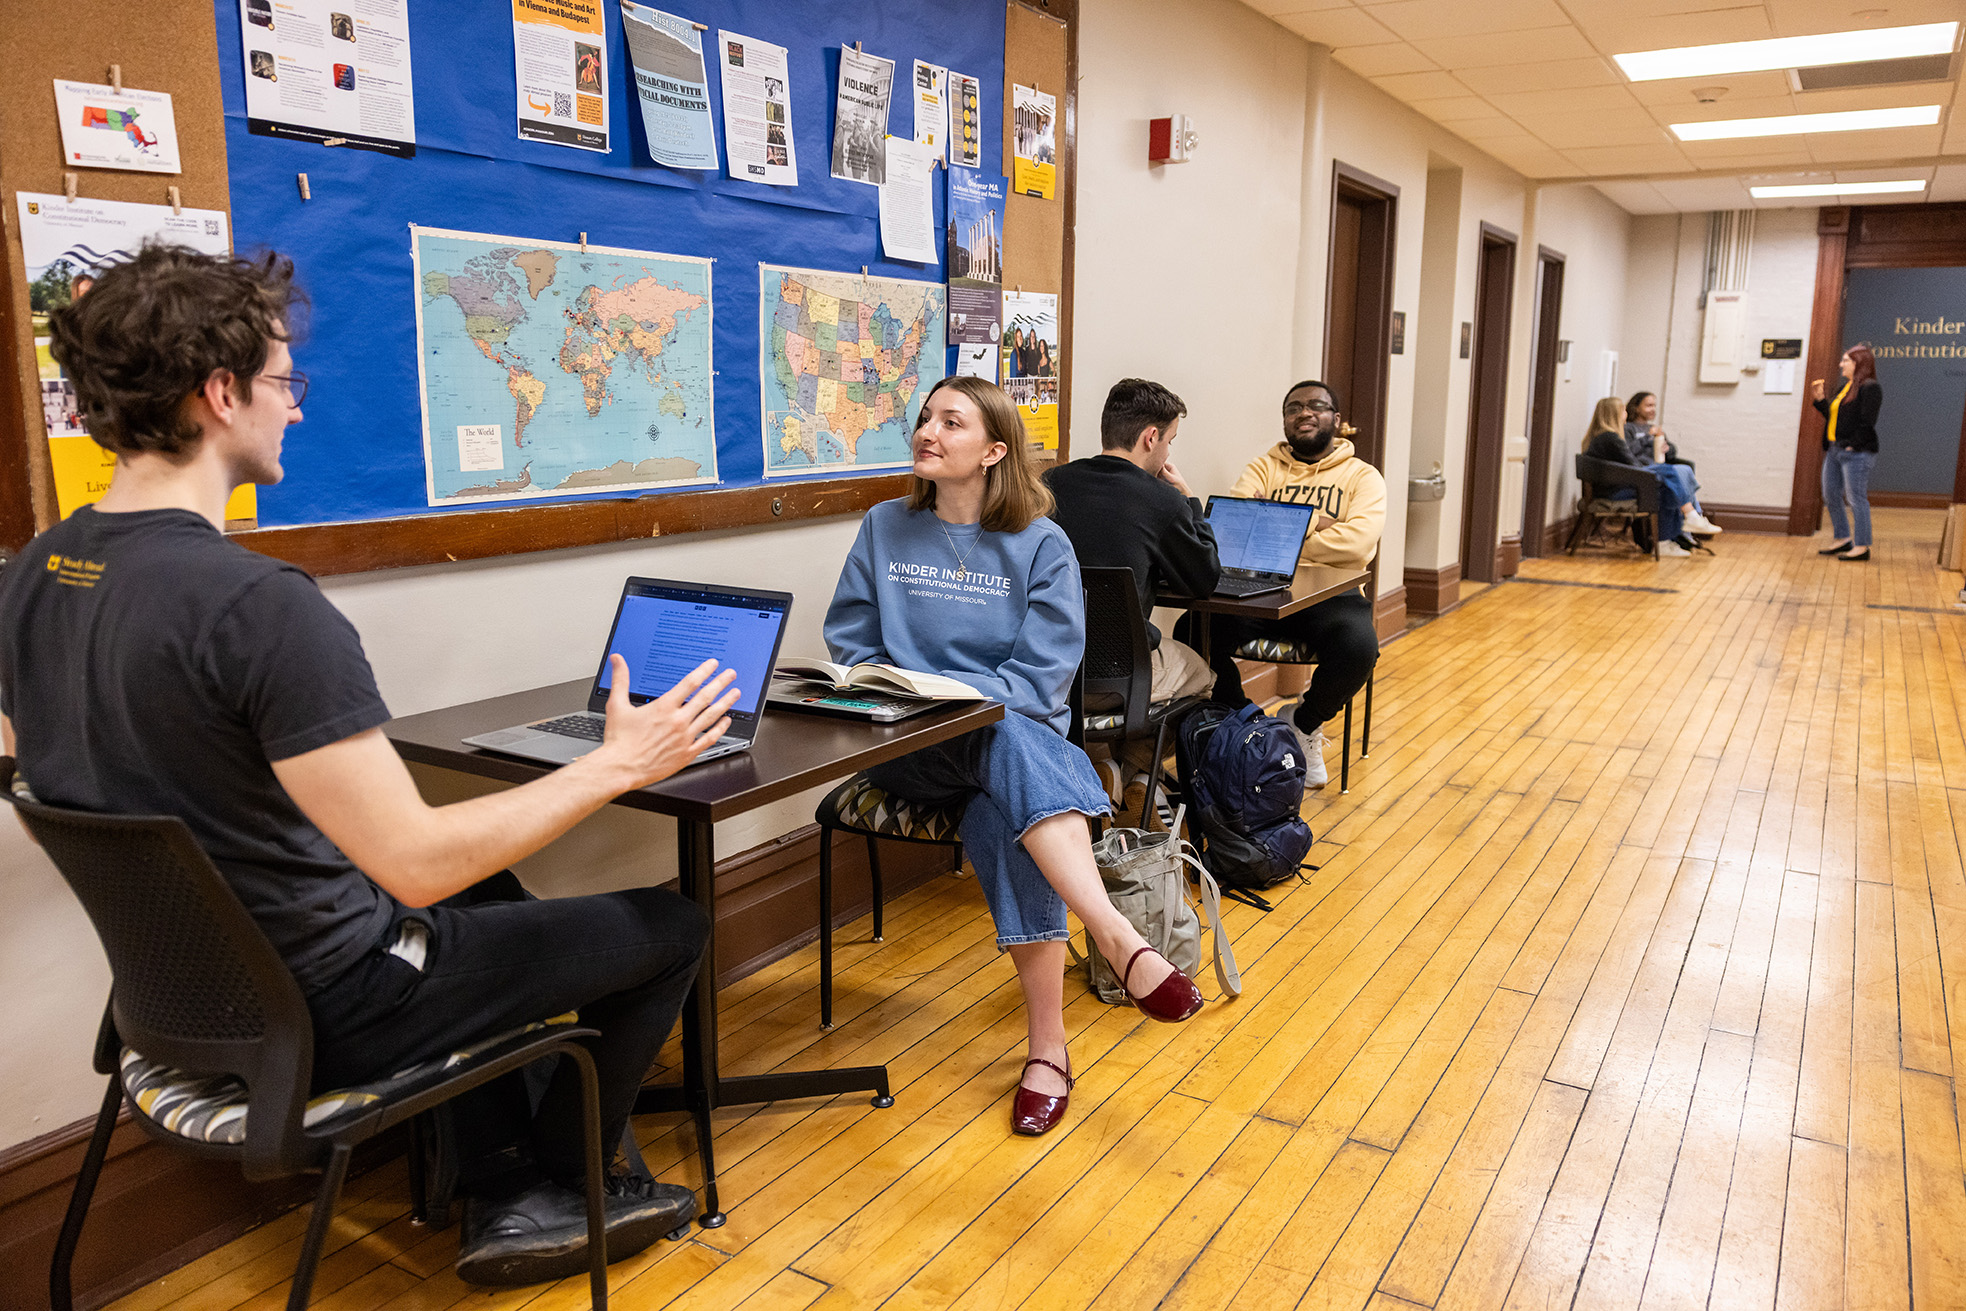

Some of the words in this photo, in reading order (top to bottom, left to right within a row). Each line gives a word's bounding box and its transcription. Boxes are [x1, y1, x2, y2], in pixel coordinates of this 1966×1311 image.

[526, 0, 548, 13] Vienna
[548, 6, 560, 17] and
[561, 9, 590, 24] Budapest
[586, 5, 596, 15] Art
[679, 85, 701, 96] WITH
[844, 76, 878, 96] VIOLENCE
[660, 93, 707, 110] DOCUMENTS
[988, 183, 999, 192] MA
[1894, 316, 1965, 334] Kinder
[1867, 340, 1966, 359] onstitutio
[464, 428, 475, 436] The
[477, 427, 494, 436] World
[889, 561, 938, 579] KINDER
[941, 568, 1011, 590] INSTITUTE
[888, 574, 900, 582] ON
[900, 575, 961, 591] CONSTITUTIONAL
[963, 584, 1010, 598] DEMOCRACY
[908, 589, 944, 599] UNIVERSITY
